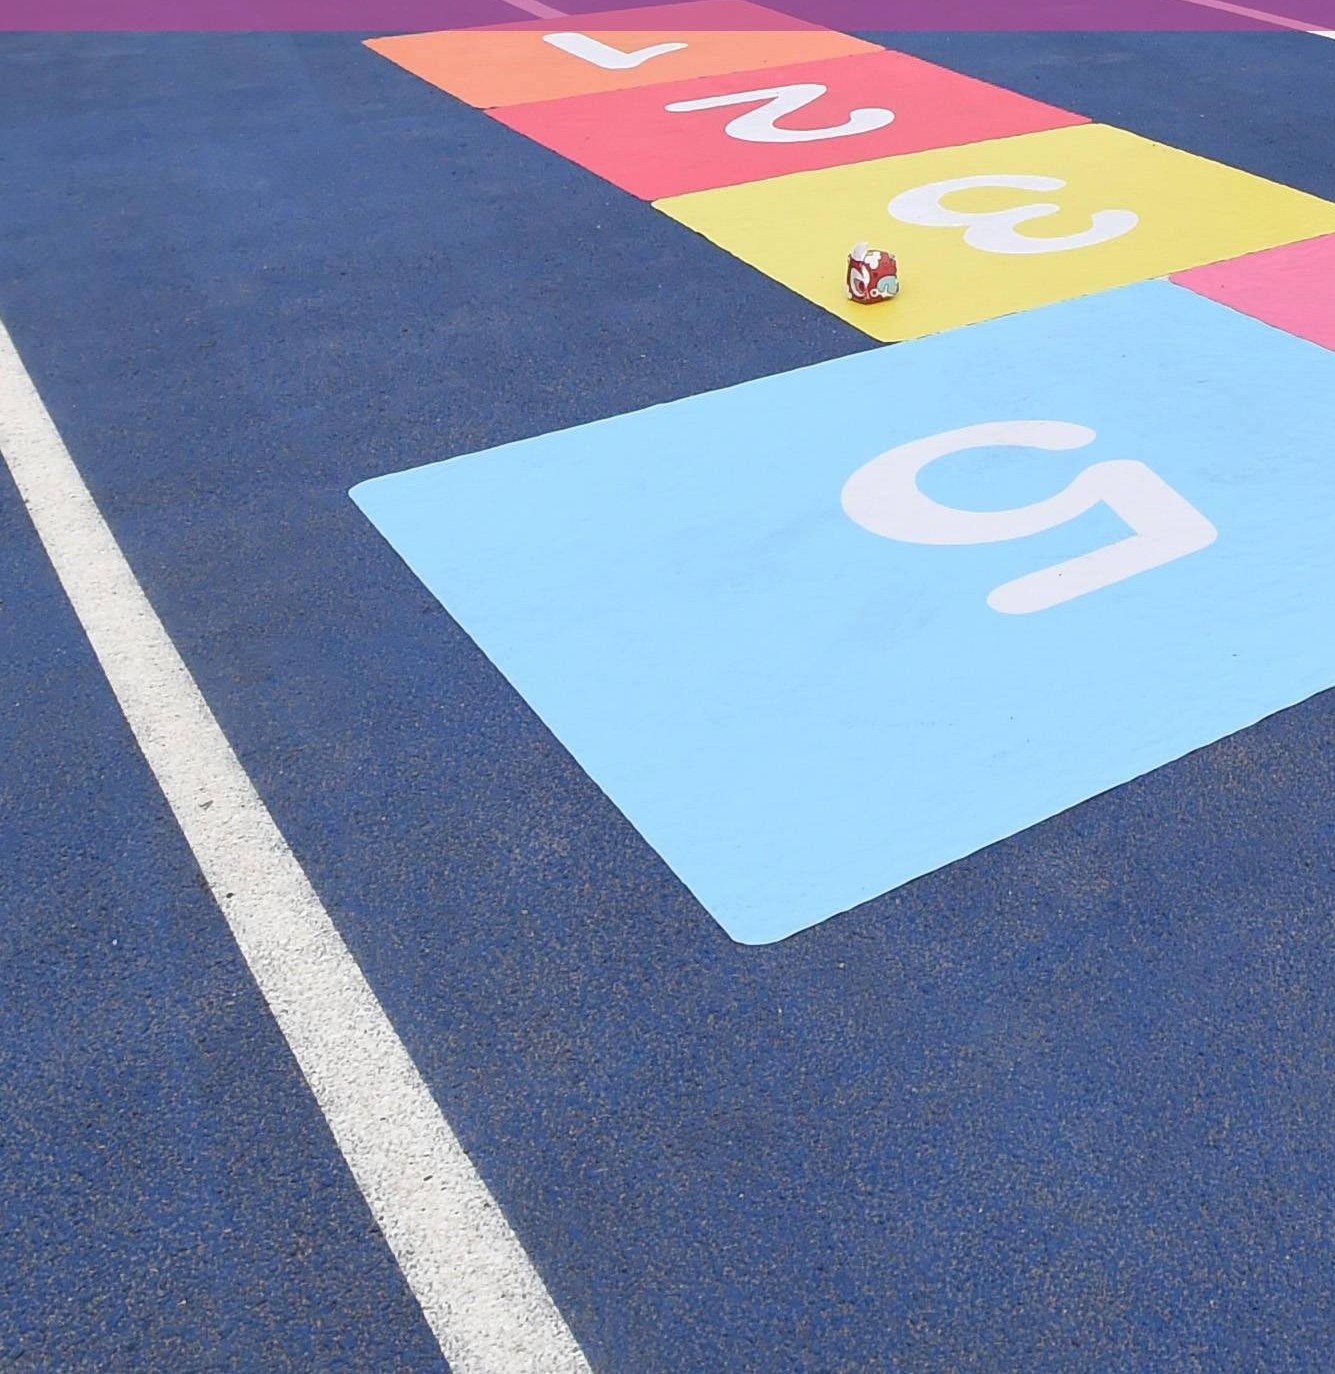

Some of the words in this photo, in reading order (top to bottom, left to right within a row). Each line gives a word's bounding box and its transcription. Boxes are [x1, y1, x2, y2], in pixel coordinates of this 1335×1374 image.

[665, 83, 895, 143] 2
[886, 173, 1140, 255] 3
[841, 420, 1219, 614] 5
